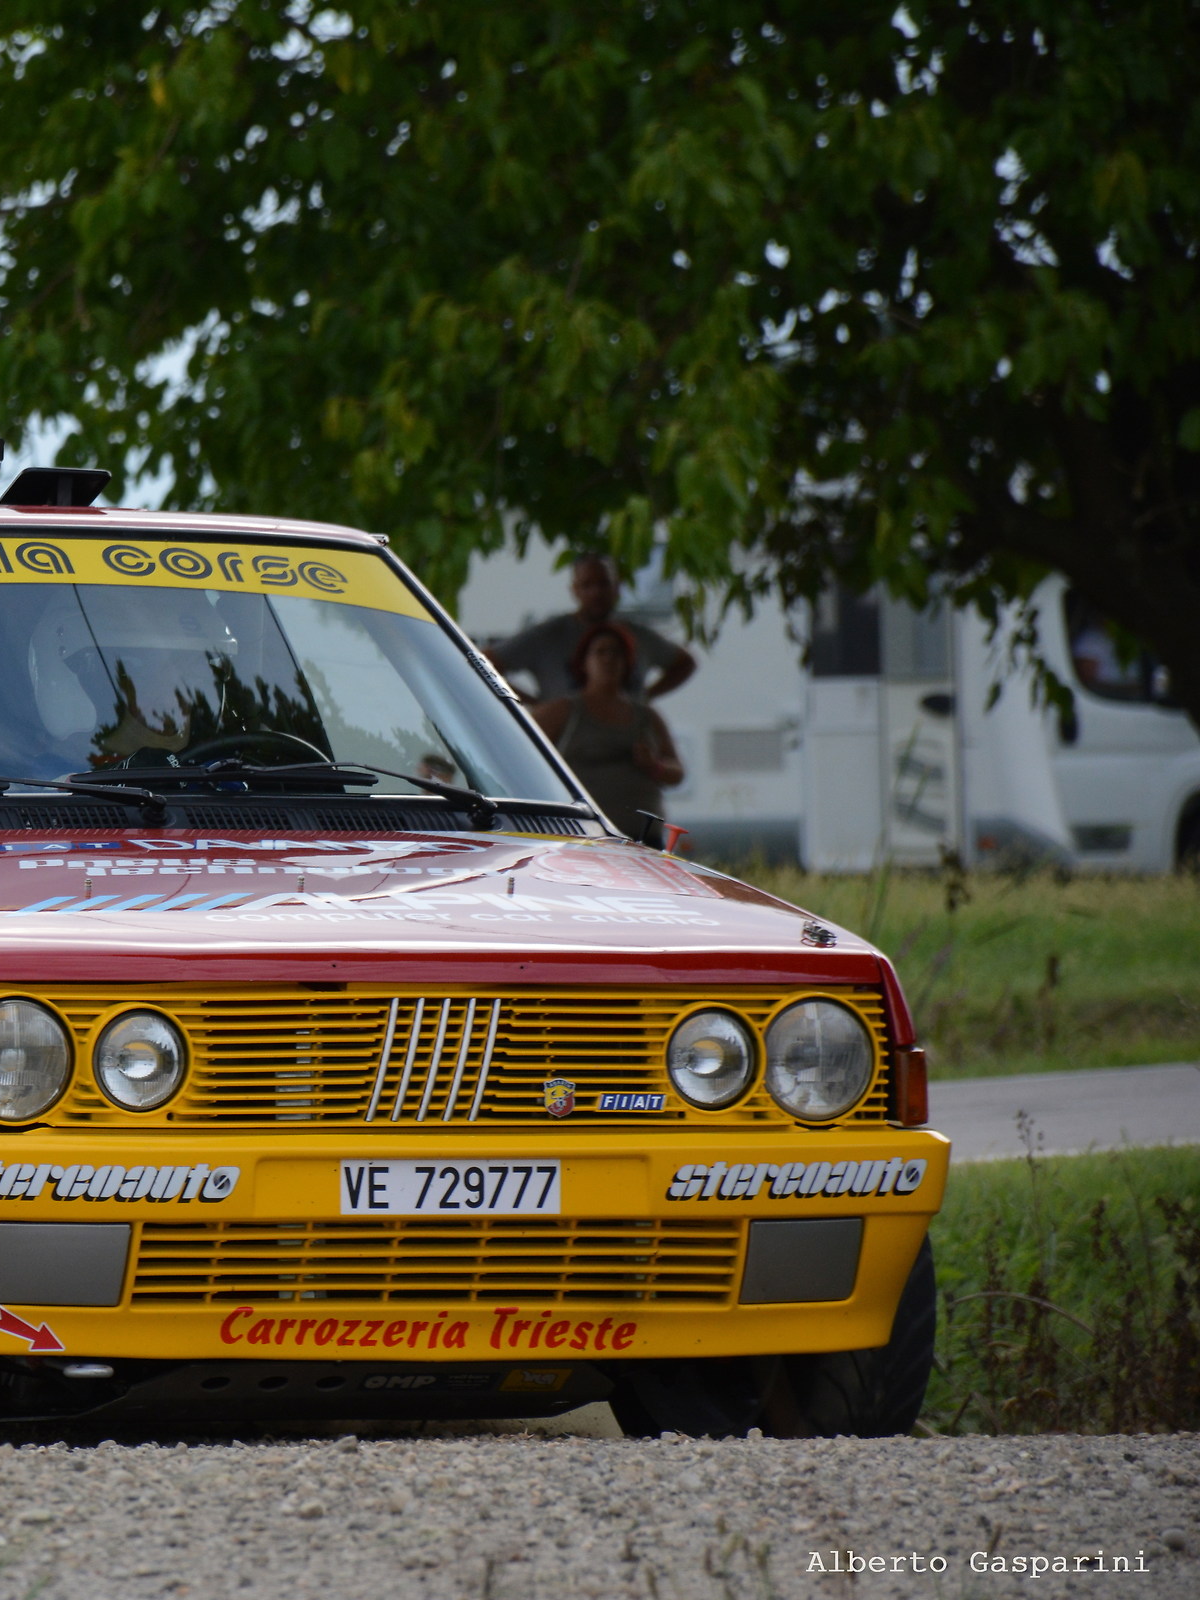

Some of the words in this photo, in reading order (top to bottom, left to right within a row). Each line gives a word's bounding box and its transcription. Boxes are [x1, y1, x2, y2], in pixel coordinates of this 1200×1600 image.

[103, 543, 349, 595] corse
[18, 857, 257, 870] Pneus
[85, 865, 511, 877] Technology
[230, 892, 703, 917] ALPINE
[204, 911, 441, 926] computer
[444, 913, 554, 925] car
[571, 912, 722, 927] audio
[603, 1095, 661, 1108] FIAT
[343, 1165, 389, 1209] VE
[414, 1165, 557, 1210] 729777
[664, 1156, 928, 1202] stereoauto
[219, 1305, 470, 1349] Carrozzeria
[488, 1306, 638, 1351] Trieste
[363, 1375, 437, 1389] OMP
